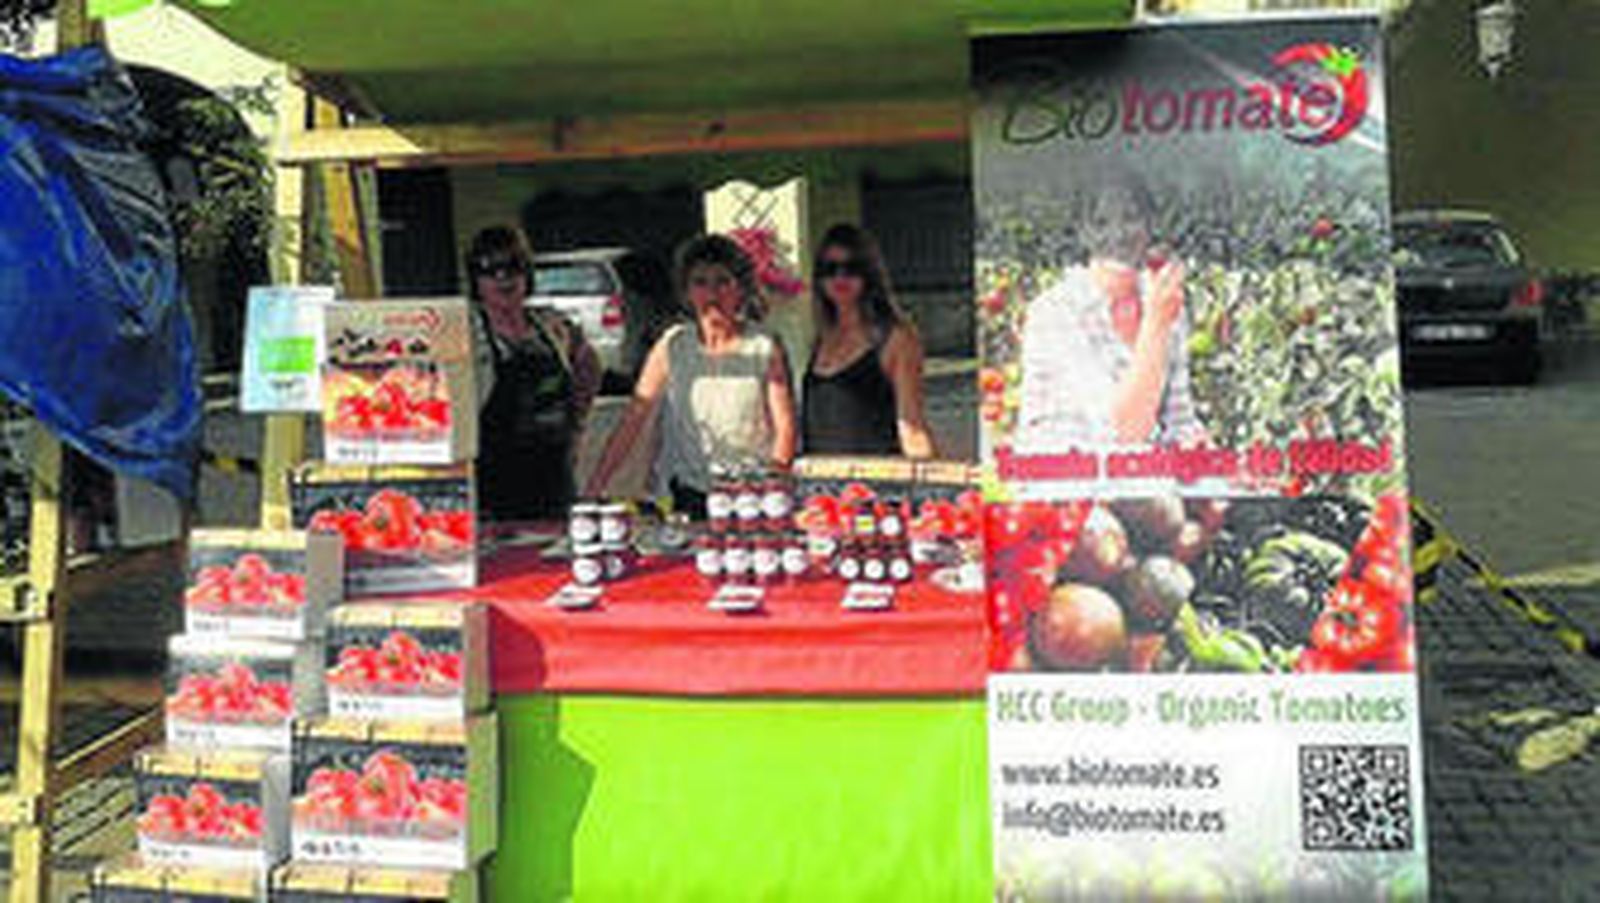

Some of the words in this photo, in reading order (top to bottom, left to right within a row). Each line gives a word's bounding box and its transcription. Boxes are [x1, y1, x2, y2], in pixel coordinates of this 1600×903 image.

[1002, 62, 1340, 146] Biotomate
[1050, 689, 1130, 728] Group
[1156, 690, 1261, 730] Organic
[1267, 690, 1408, 724] Tomatoes
[1000, 755, 1221, 789] www.biotomate.es
[1001, 801, 1227, 836] info@biotomate.es
